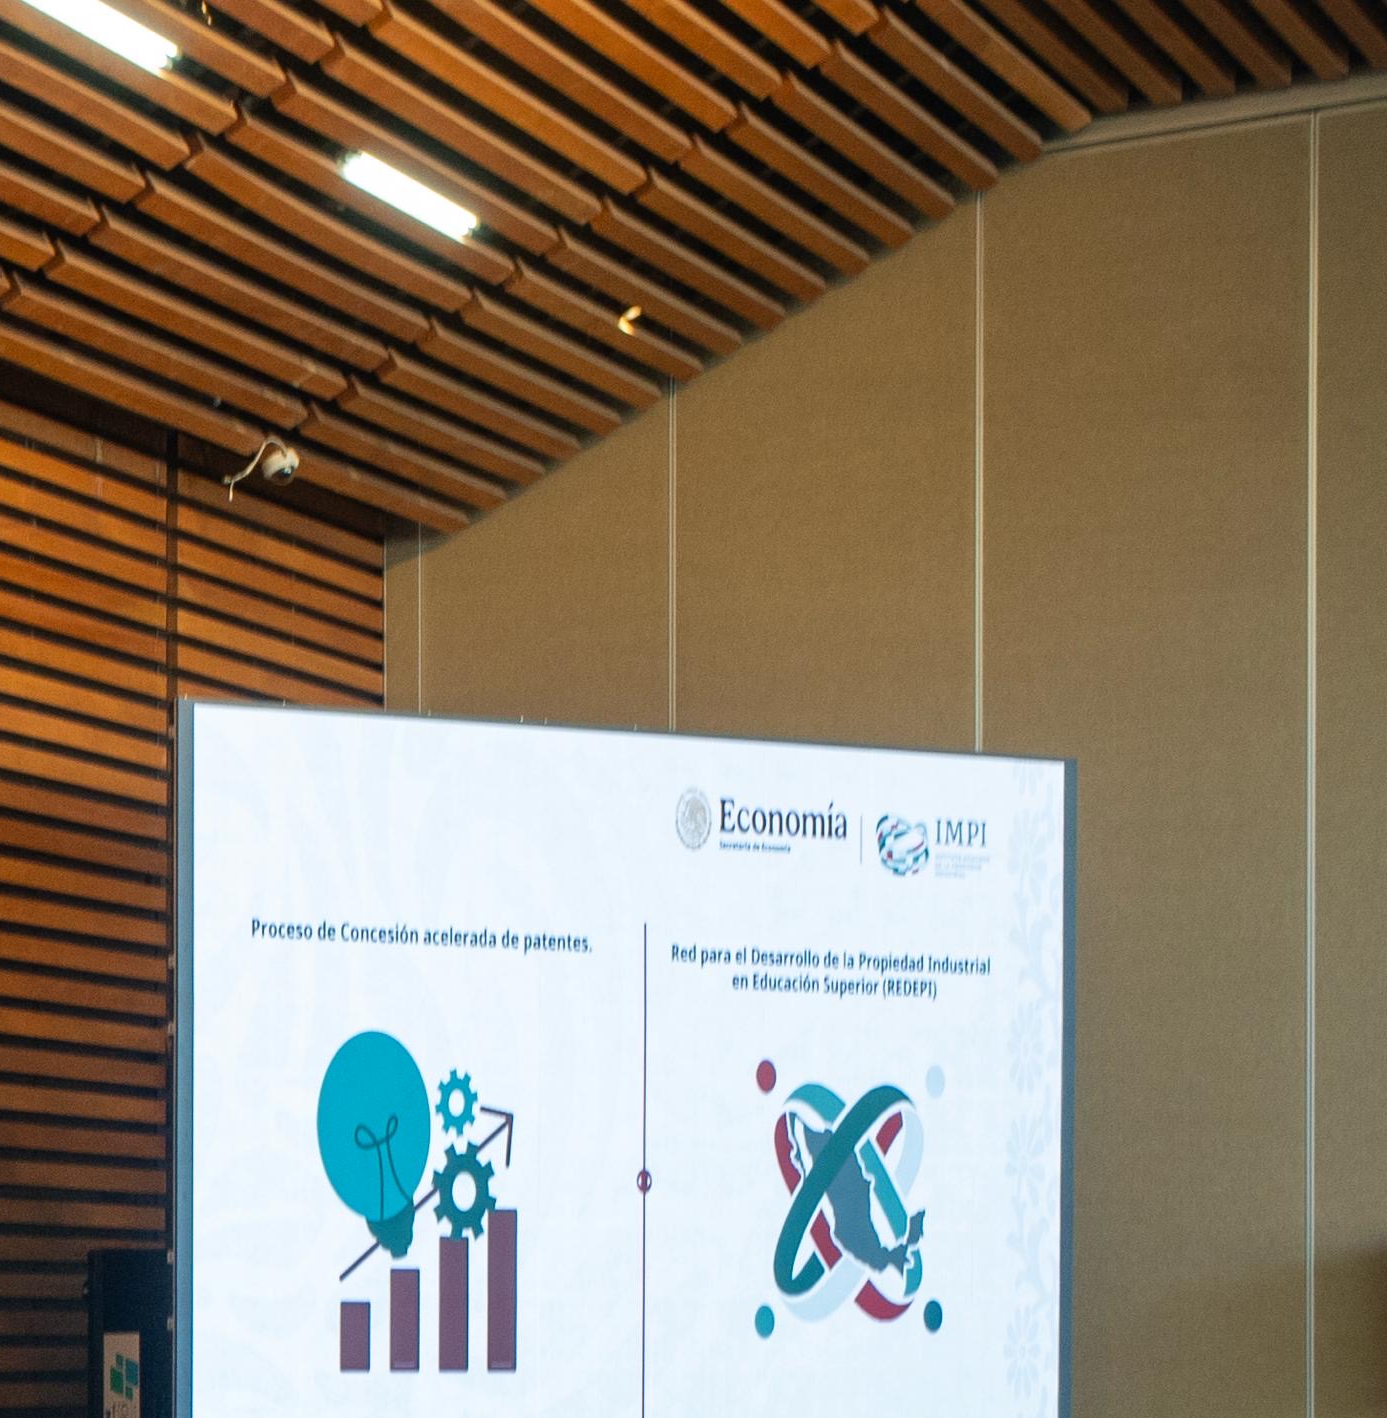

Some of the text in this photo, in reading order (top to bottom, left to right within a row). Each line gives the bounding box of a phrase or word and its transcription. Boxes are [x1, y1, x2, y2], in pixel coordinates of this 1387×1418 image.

[719, 797, 987, 848] Economía IMPI
[252, 918, 593, 956] Proceso de Concesión acelerada de patentes.
[671, 943, 991, 975] Red para el Desarrollo de la Propiedad Industrial
[732, 972, 938, 1001] en Educación Superior (REDEPI)
